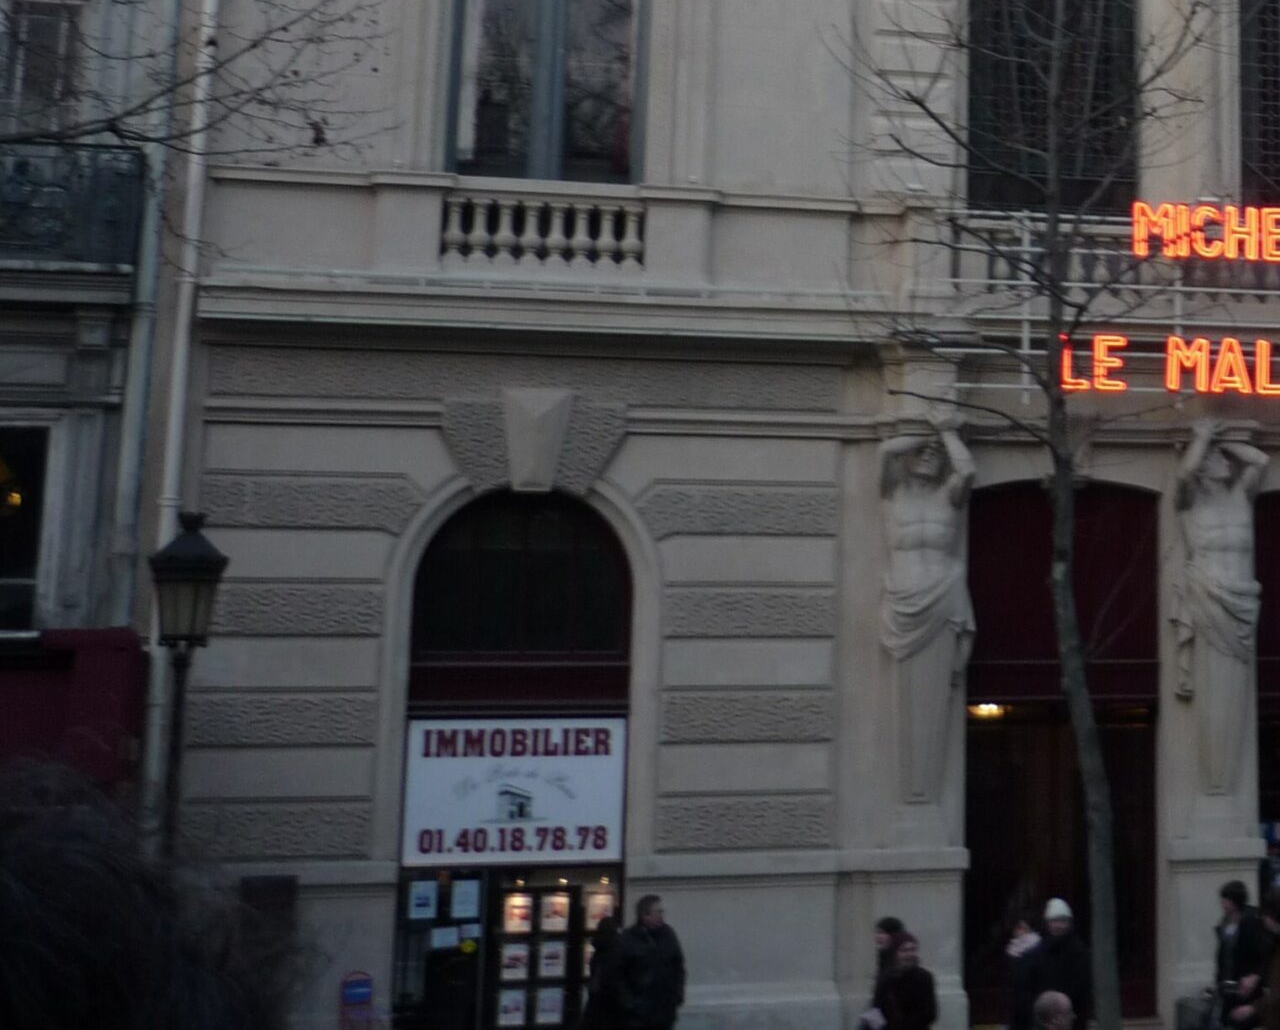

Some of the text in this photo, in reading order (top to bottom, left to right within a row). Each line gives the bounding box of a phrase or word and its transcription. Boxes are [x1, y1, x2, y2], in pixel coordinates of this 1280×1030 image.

[1057, 333, 1128, 392] LE
[421, 726, 612, 758] IMMOBILIER
[417, 825, 608, 854] 01.40.18.78.78
